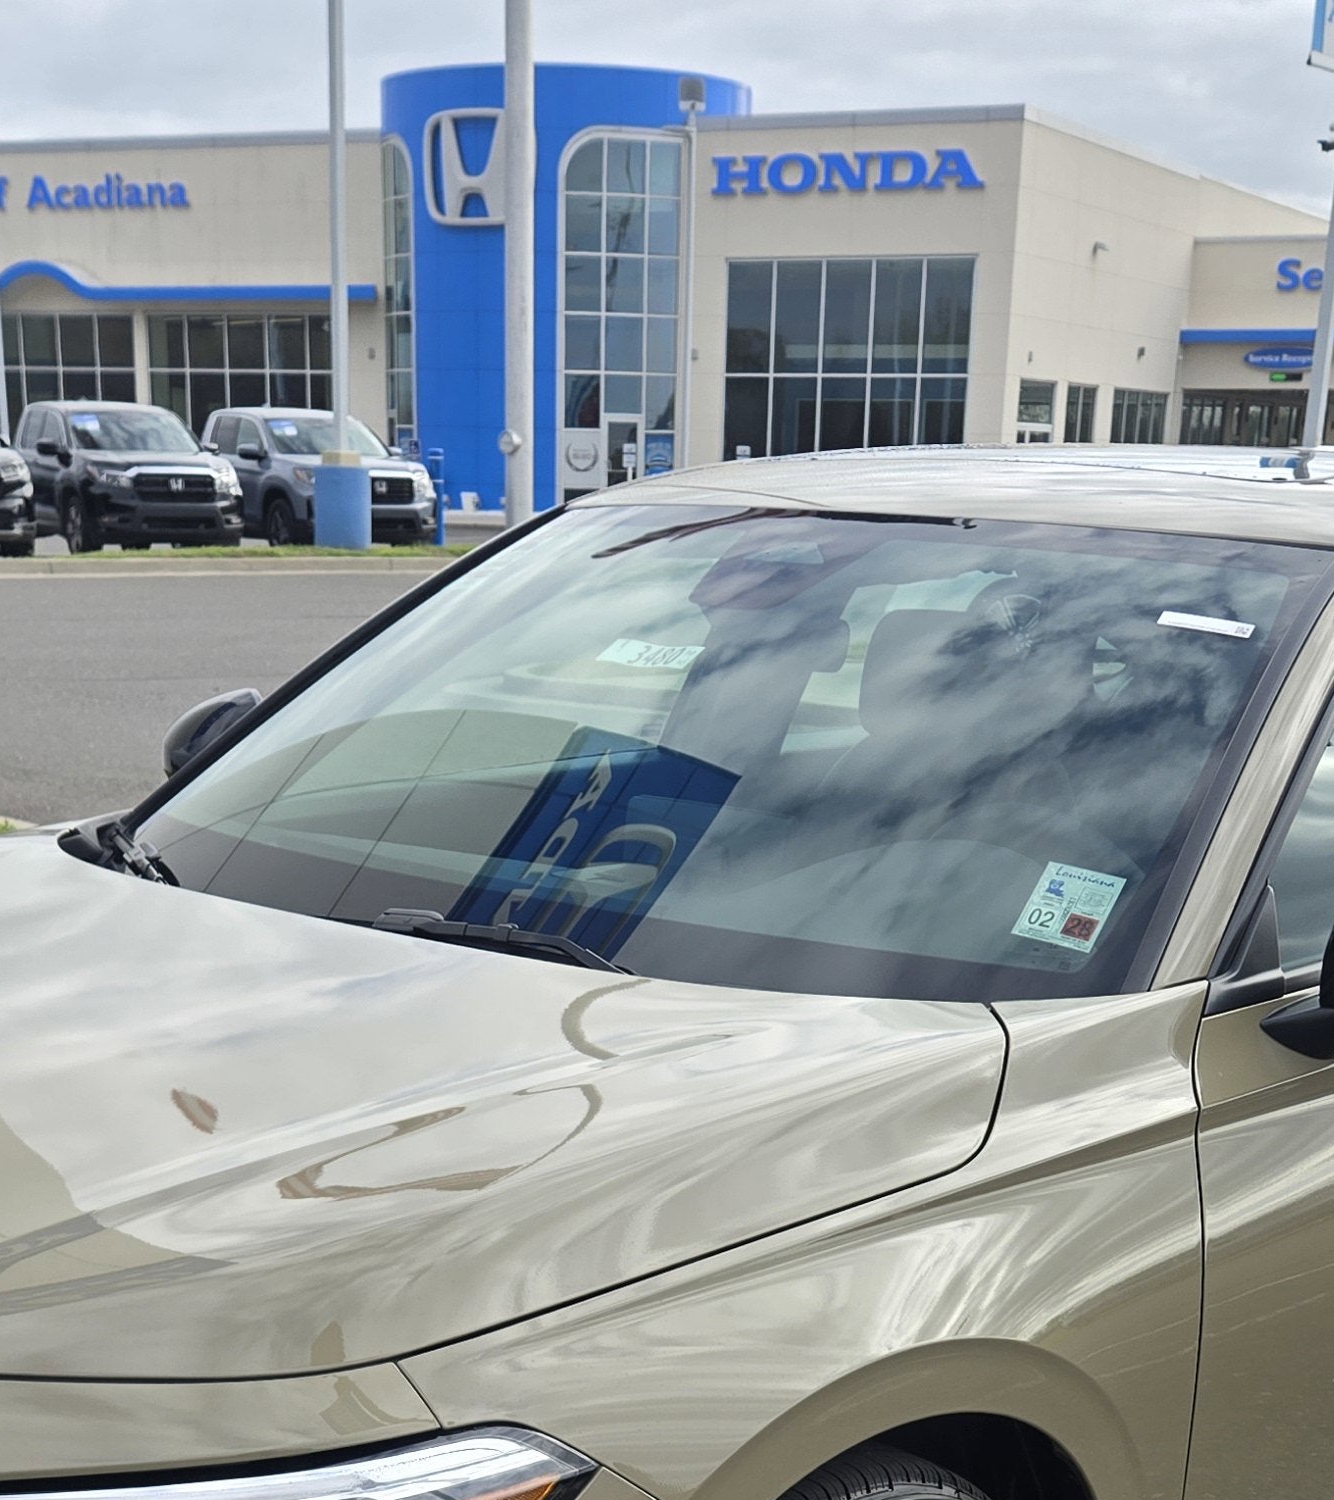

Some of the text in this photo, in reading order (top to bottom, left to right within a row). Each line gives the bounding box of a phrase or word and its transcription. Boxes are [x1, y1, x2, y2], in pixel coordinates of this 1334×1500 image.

[712, 148, 985, 196] HONDA
[27, 174, 189, 210] Acadiana
[1281, 352, 1313, 364] Recep
[1055, 865, 1116, 888] Louisiana
[1028, 908, 1055, 929] 02
